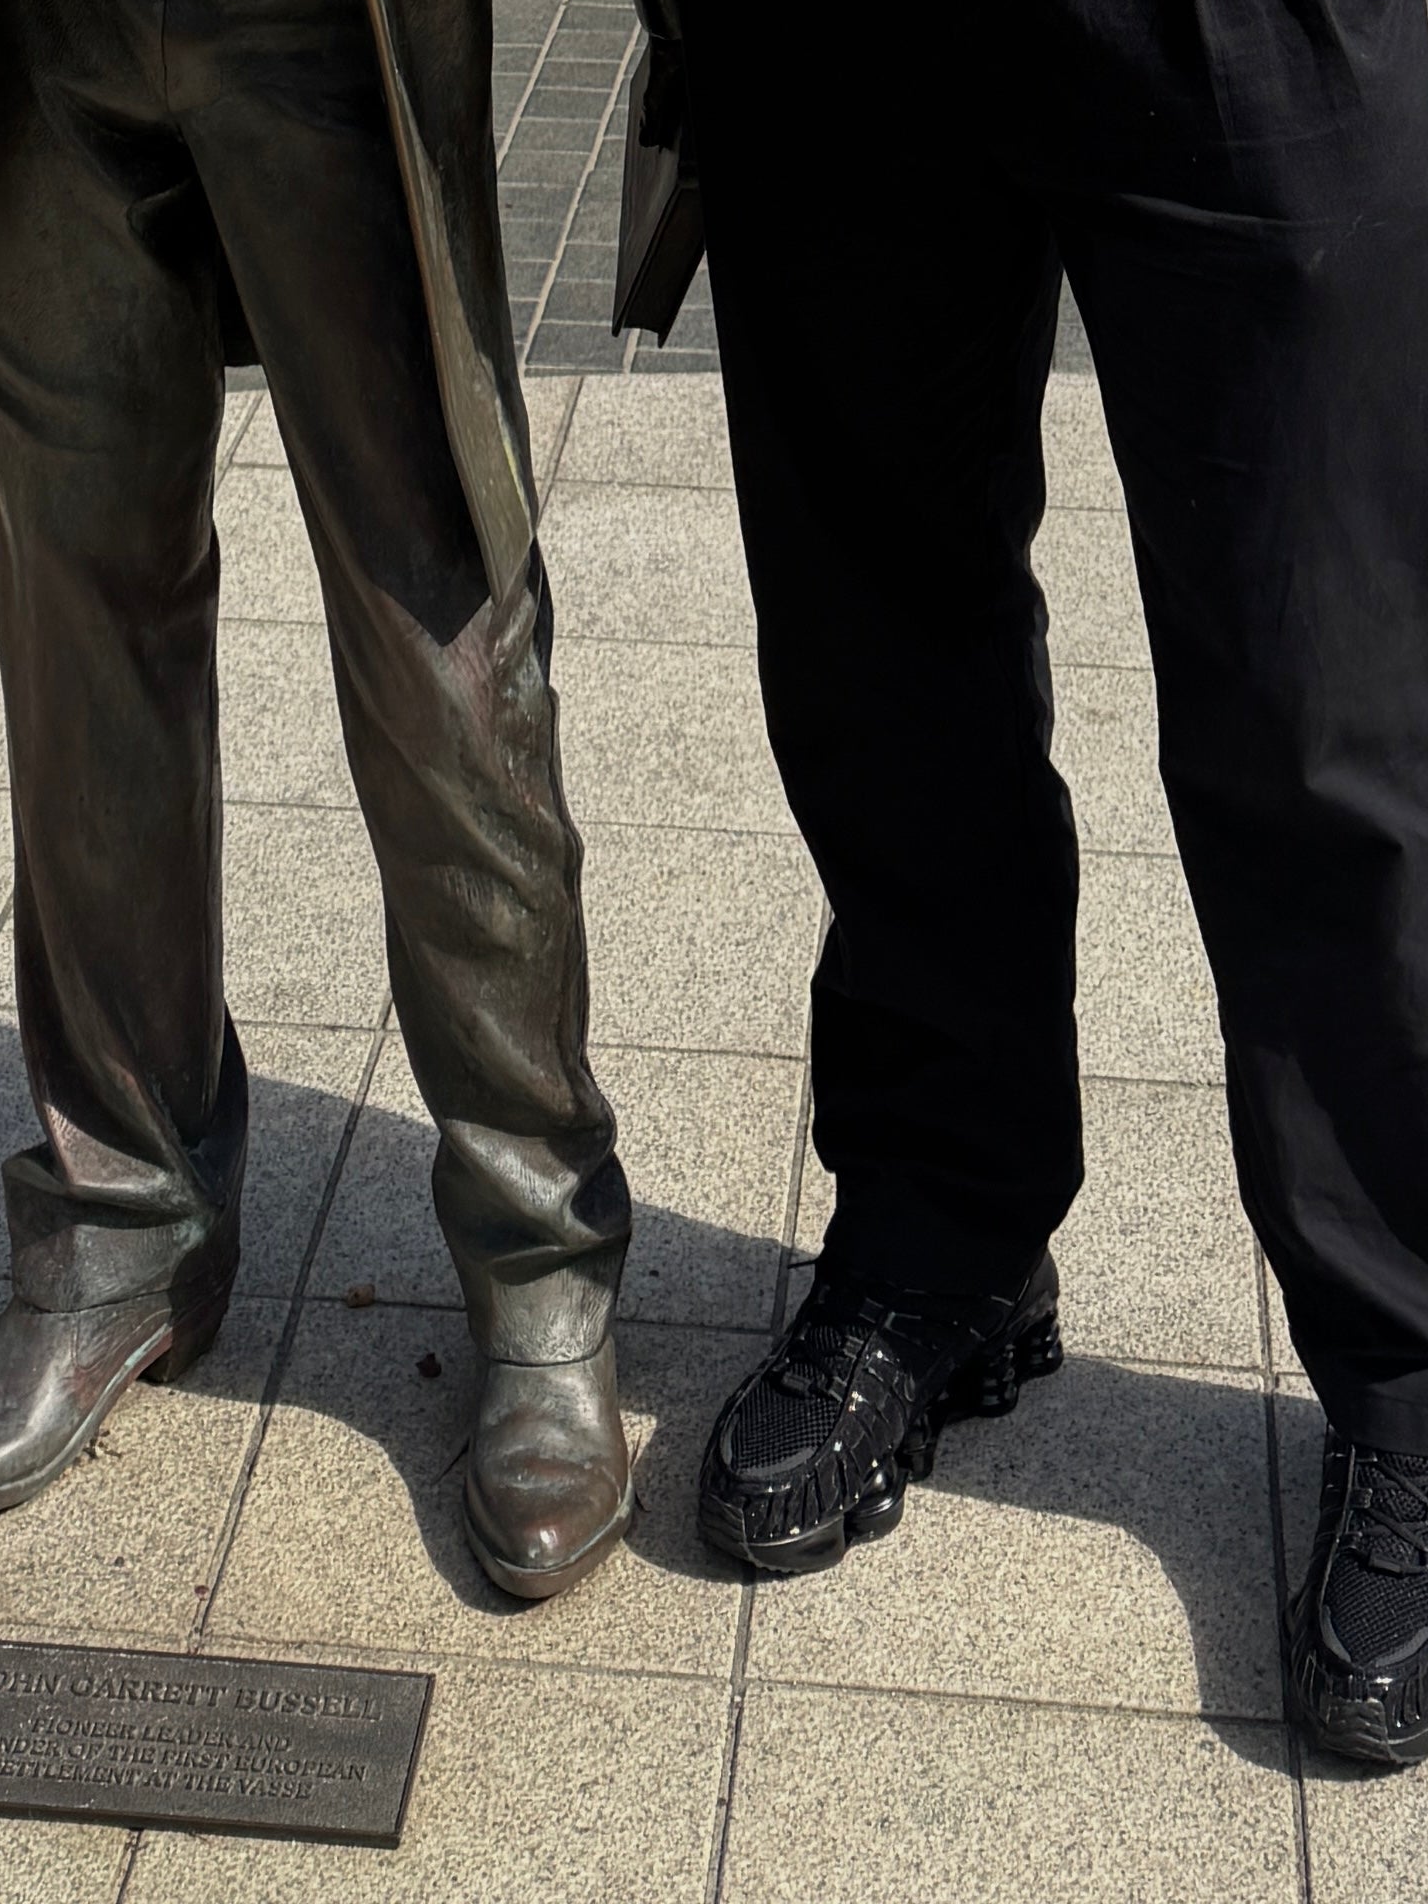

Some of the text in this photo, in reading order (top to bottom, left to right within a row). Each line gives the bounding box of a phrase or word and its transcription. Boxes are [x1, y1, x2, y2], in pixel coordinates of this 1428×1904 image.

[70, 1676, 228, 1708] GARRETT
[234, 1688, 382, 1721] BUSSELL
[31, 1718, 291, 1753] PIONEER LEADER AND
[67, 1742, 103, 1761] OF
[108, 1744, 158, 1764] THE
[160, 1749, 232, 1770] FIRST
[234, 1755, 368, 1783] EUROPEAN
[143, 1769, 180, 1790] AT
[184, 1772, 234, 1793] THE
[237, 1777, 315, 1800] VASSE
